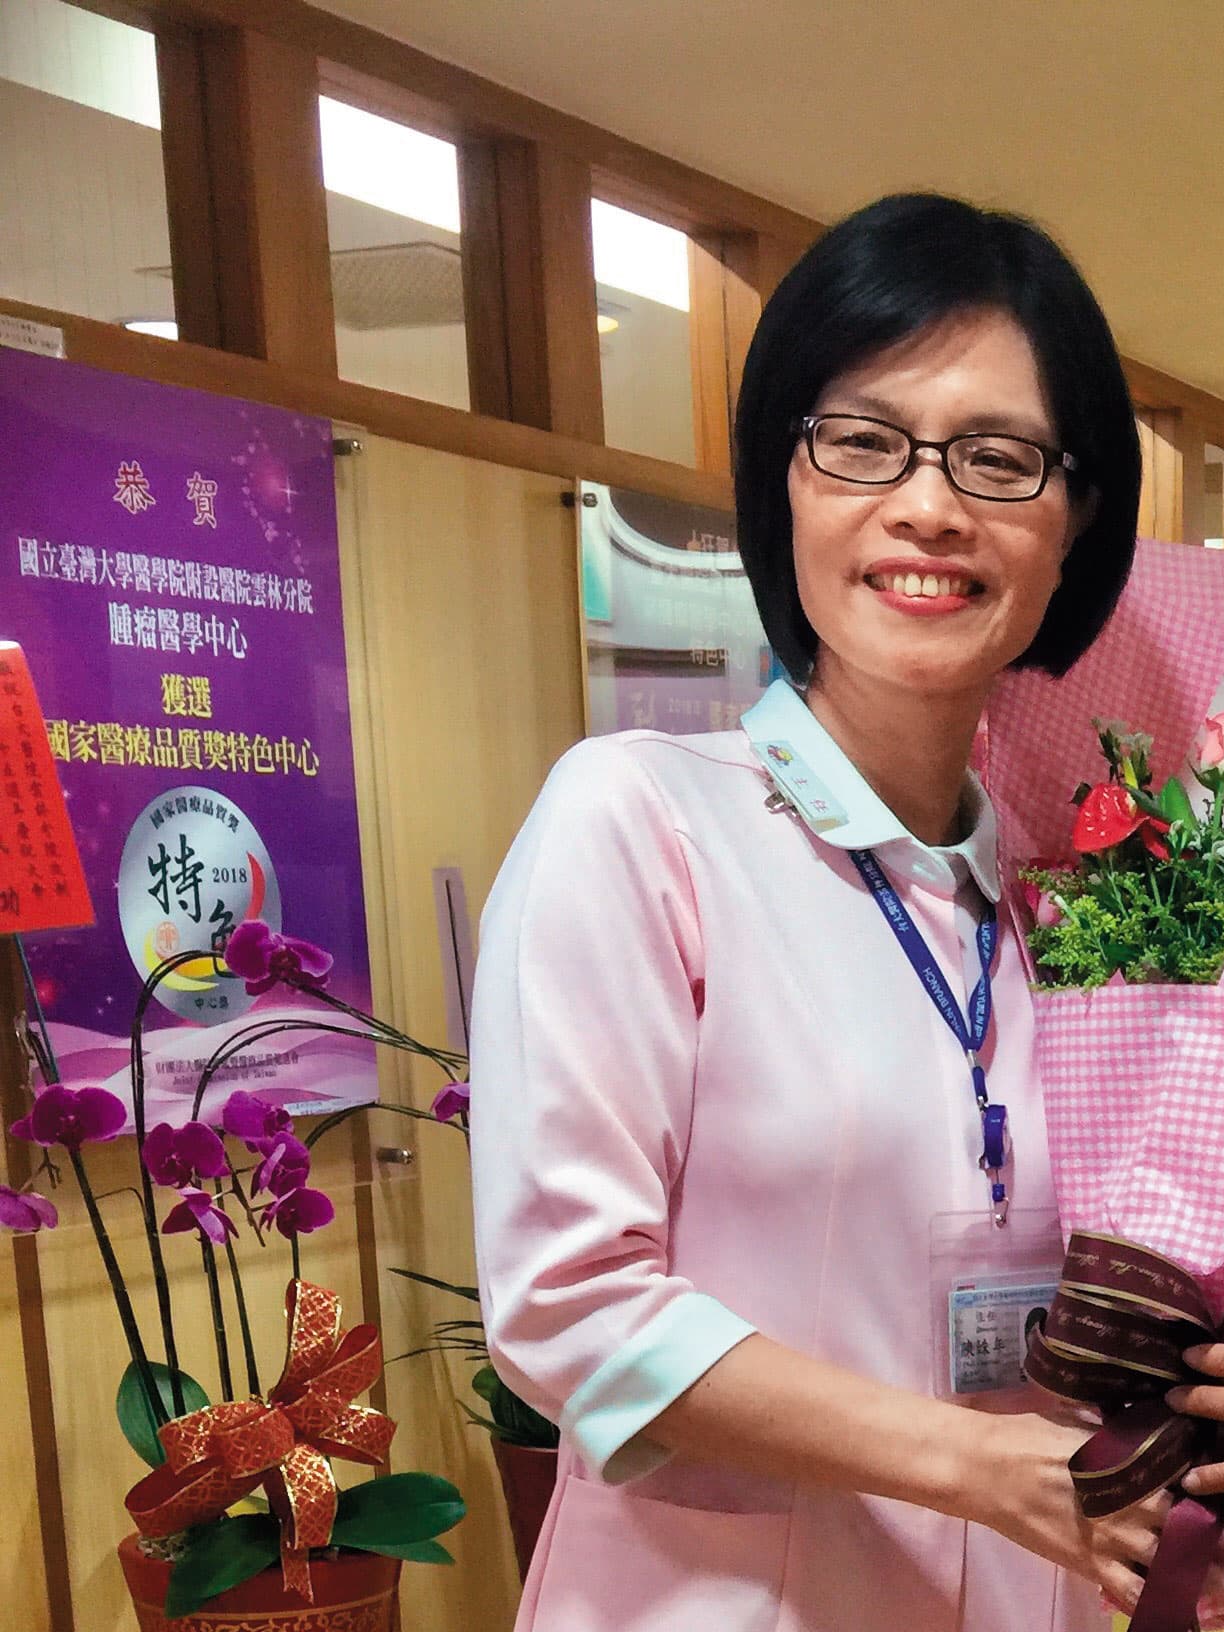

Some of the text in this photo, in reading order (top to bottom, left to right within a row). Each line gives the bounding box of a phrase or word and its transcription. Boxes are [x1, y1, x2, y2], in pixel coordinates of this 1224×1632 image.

[113, 460, 218, 528] 恭賀
[18, 536, 314, 615] 國立臺灣大學醫學院附設醫院雲林分院
[108, 601, 248, 659] 腫瘤醫學中心
[161, 673, 213, 718] 獲選
[212, 867, 248, 883] 2018
[922, 966, 951, 1010] BRANCH
